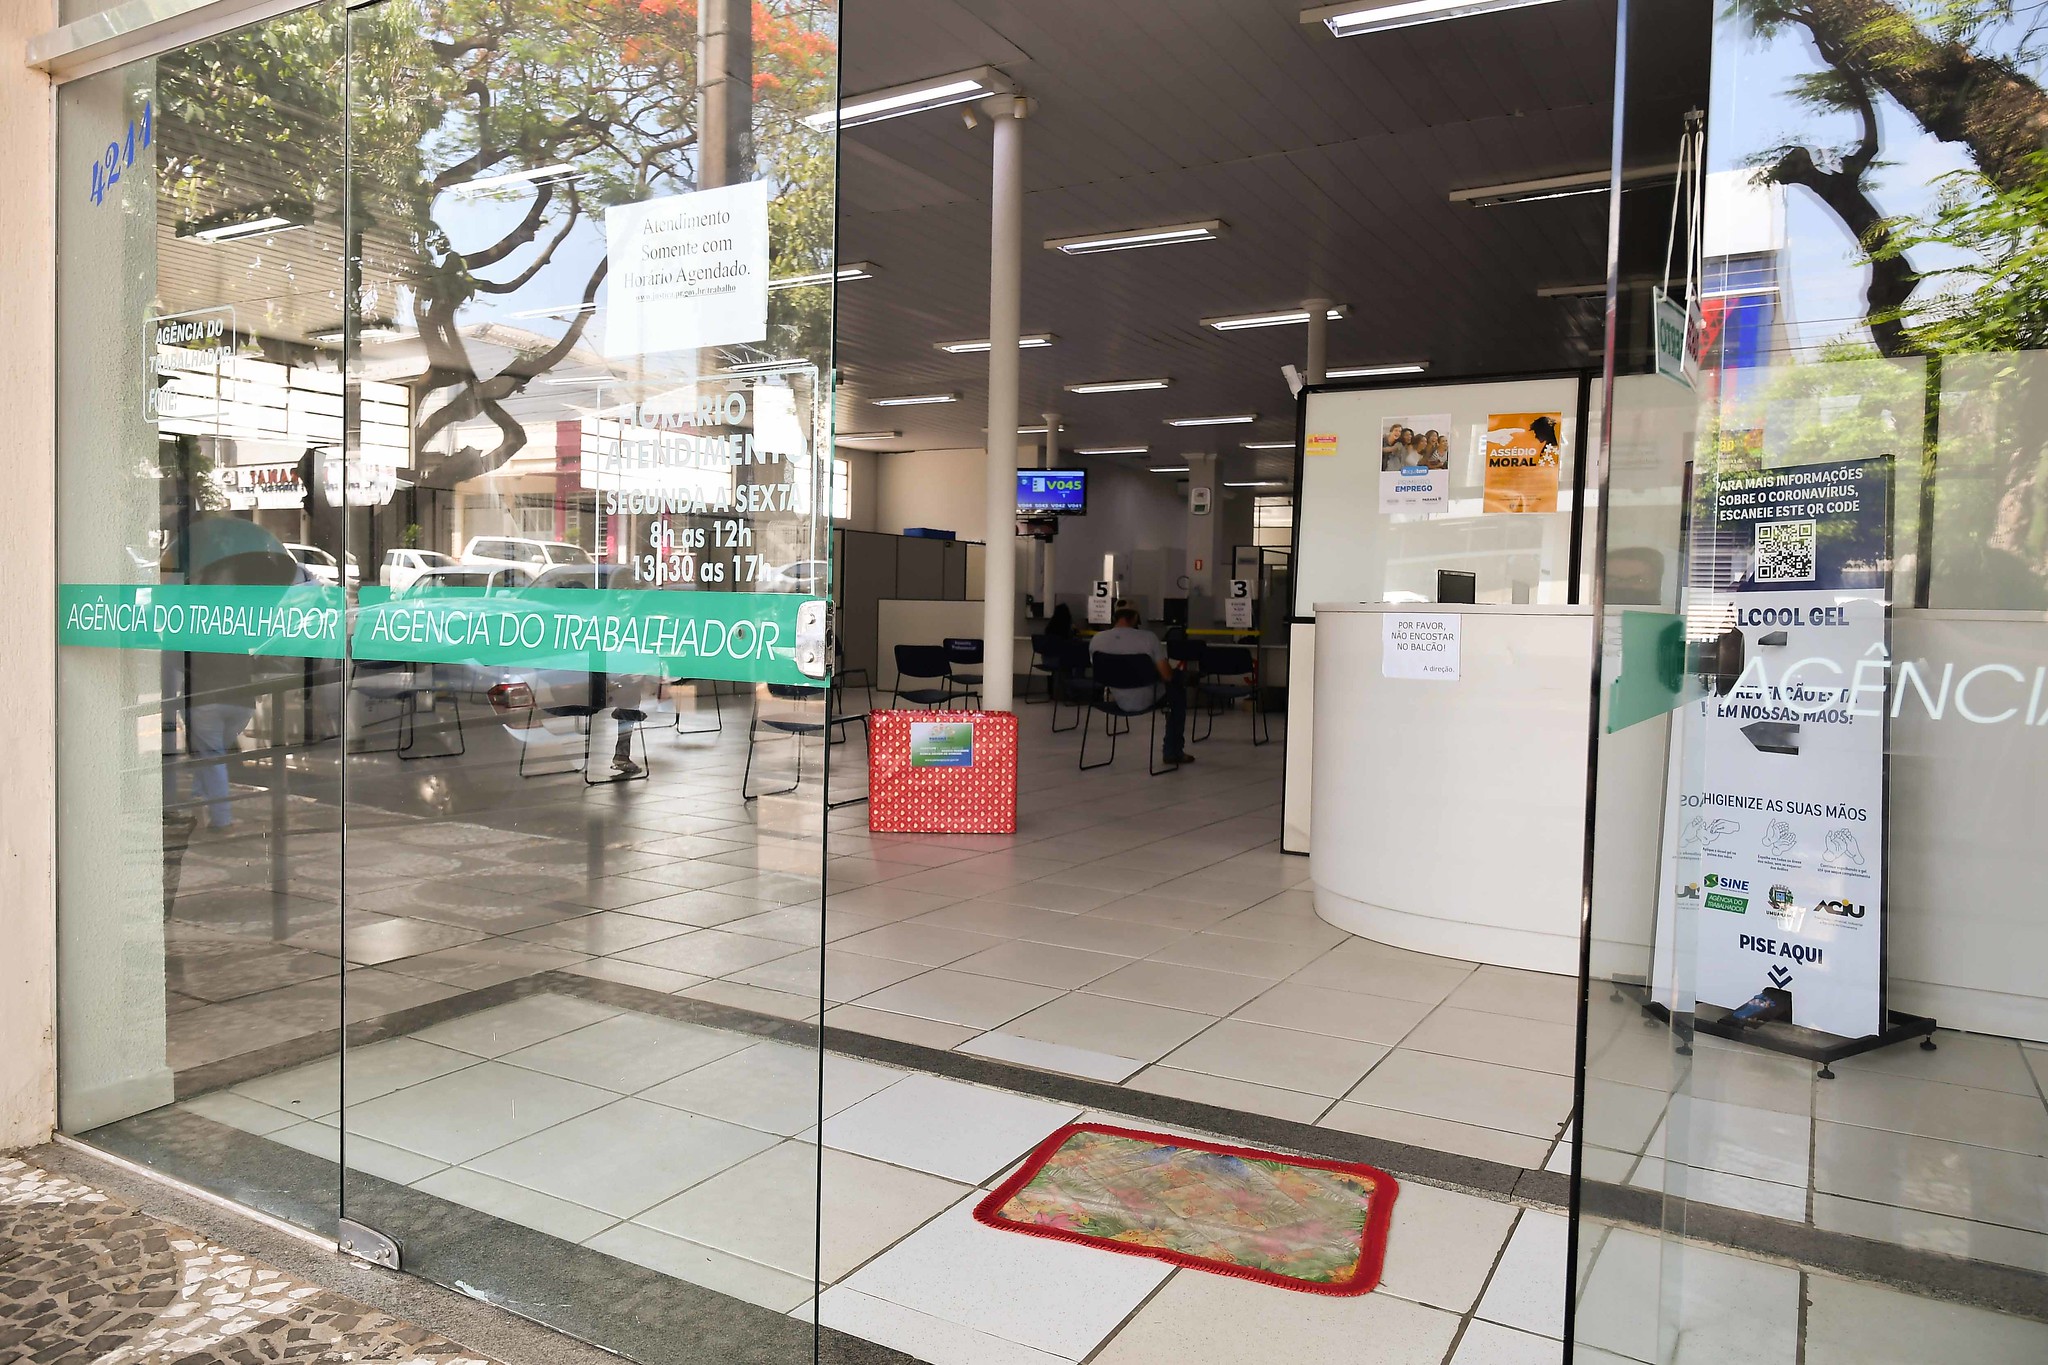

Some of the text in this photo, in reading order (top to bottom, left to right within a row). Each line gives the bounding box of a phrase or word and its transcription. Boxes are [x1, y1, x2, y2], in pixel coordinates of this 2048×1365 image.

[90, 100, 151, 206] 4211
[643, 210, 730, 235] Atendimento
[641, 237, 732, 262] Somente com
[624, 260, 751, 289] Horário Agendado.
[155, 318, 224, 345] AGÊNCIA DO
[1489, 447, 1537, 457] ASSÉDIO
[1489, 457, 1537, 467] MORAL
[1046, 480, 1082, 490] V045
[1745, 476, 1774, 490] MAIS
[1777, 466, 1864, 486] INFORMAÇÕES
[606, 483, 803, 515] SEGUNDA A SEXTA
[1719, 484, 1859, 506] SOBRE O CORONAVÍRUS,
[1720, 500, 1860, 521] ESCANEIE ESTE QR CODE
[650, 519, 752, 548] 8h as 12h
[633, 553, 773, 582] 13h30 as 17h
[1096, 582, 1108, 598] 5
[1234, 581, 1247, 598] 3
[67, 595, 338, 640] AGÊNCIA DO TRABALHADOR
[1728, 604, 1850, 626] LCOOL GEL
[371, 599, 780, 661] AGÊNCIA DO TRABALHADOR
[1391, 630, 1454, 640] NÃO ENCOSTAR
[1398, 622, 1446, 631] POR FAVOR,
[1410, 642, 1446, 652] BALCÃO!
[1723, 642, 2048, 726] AGÊNCI
[1731, 683, 1814, 703] REVNÃO
[1718, 704, 1738, 718] EM
[1741, 705, 1800, 721] NOSSAS
[1704, 792, 1763, 810] HIGIENIZE
[1766, 799, 1783, 812] AS
[1786, 801, 1822, 816] SUAS
[1826, 803, 1867, 822] MÃOS
[1720, 877, 1750, 891] SINE
[1707, 901, 1744, 913] TRABALHADOR
[1708, 894, 1732, 905] AGÊNCIA
[1740, 934, 1822, 966] PISE AQUI
